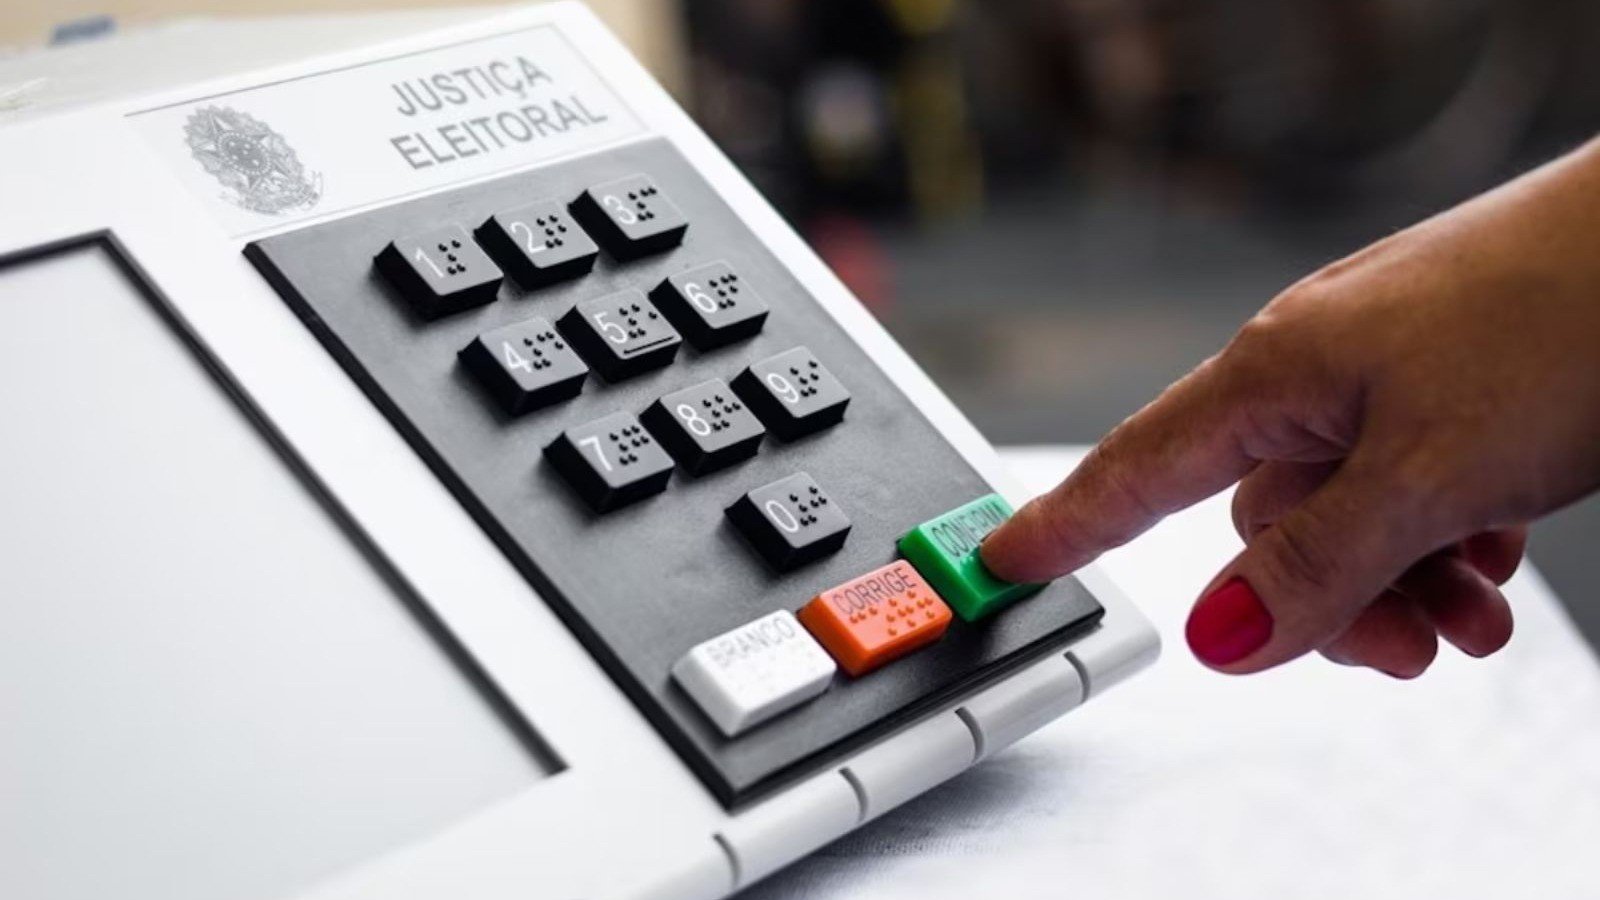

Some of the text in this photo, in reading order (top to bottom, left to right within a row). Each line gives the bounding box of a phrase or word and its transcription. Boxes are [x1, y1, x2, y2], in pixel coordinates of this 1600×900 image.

[391, 55, 553, 117] JUSTIÇA
[390, 95, 608, 170] ELEITORAL
[603, 195, 637, 226] 3
[510, 221, 548, 254] 2
[414, 247, 445, 280] 1
[684, 282, 718, 314] 6
[593, 311, 628, 345] 5
[502, 340, 534, 375] 4
[766, 372, 800, 404] 9
[676, 403, 712, 437] 8
[578, 435, 614, 472] 7
[765, 500, 799, 533] 0
[832, 567, 917, 615] CORRIGE
[705, 617, 796, 670] BRANCO
